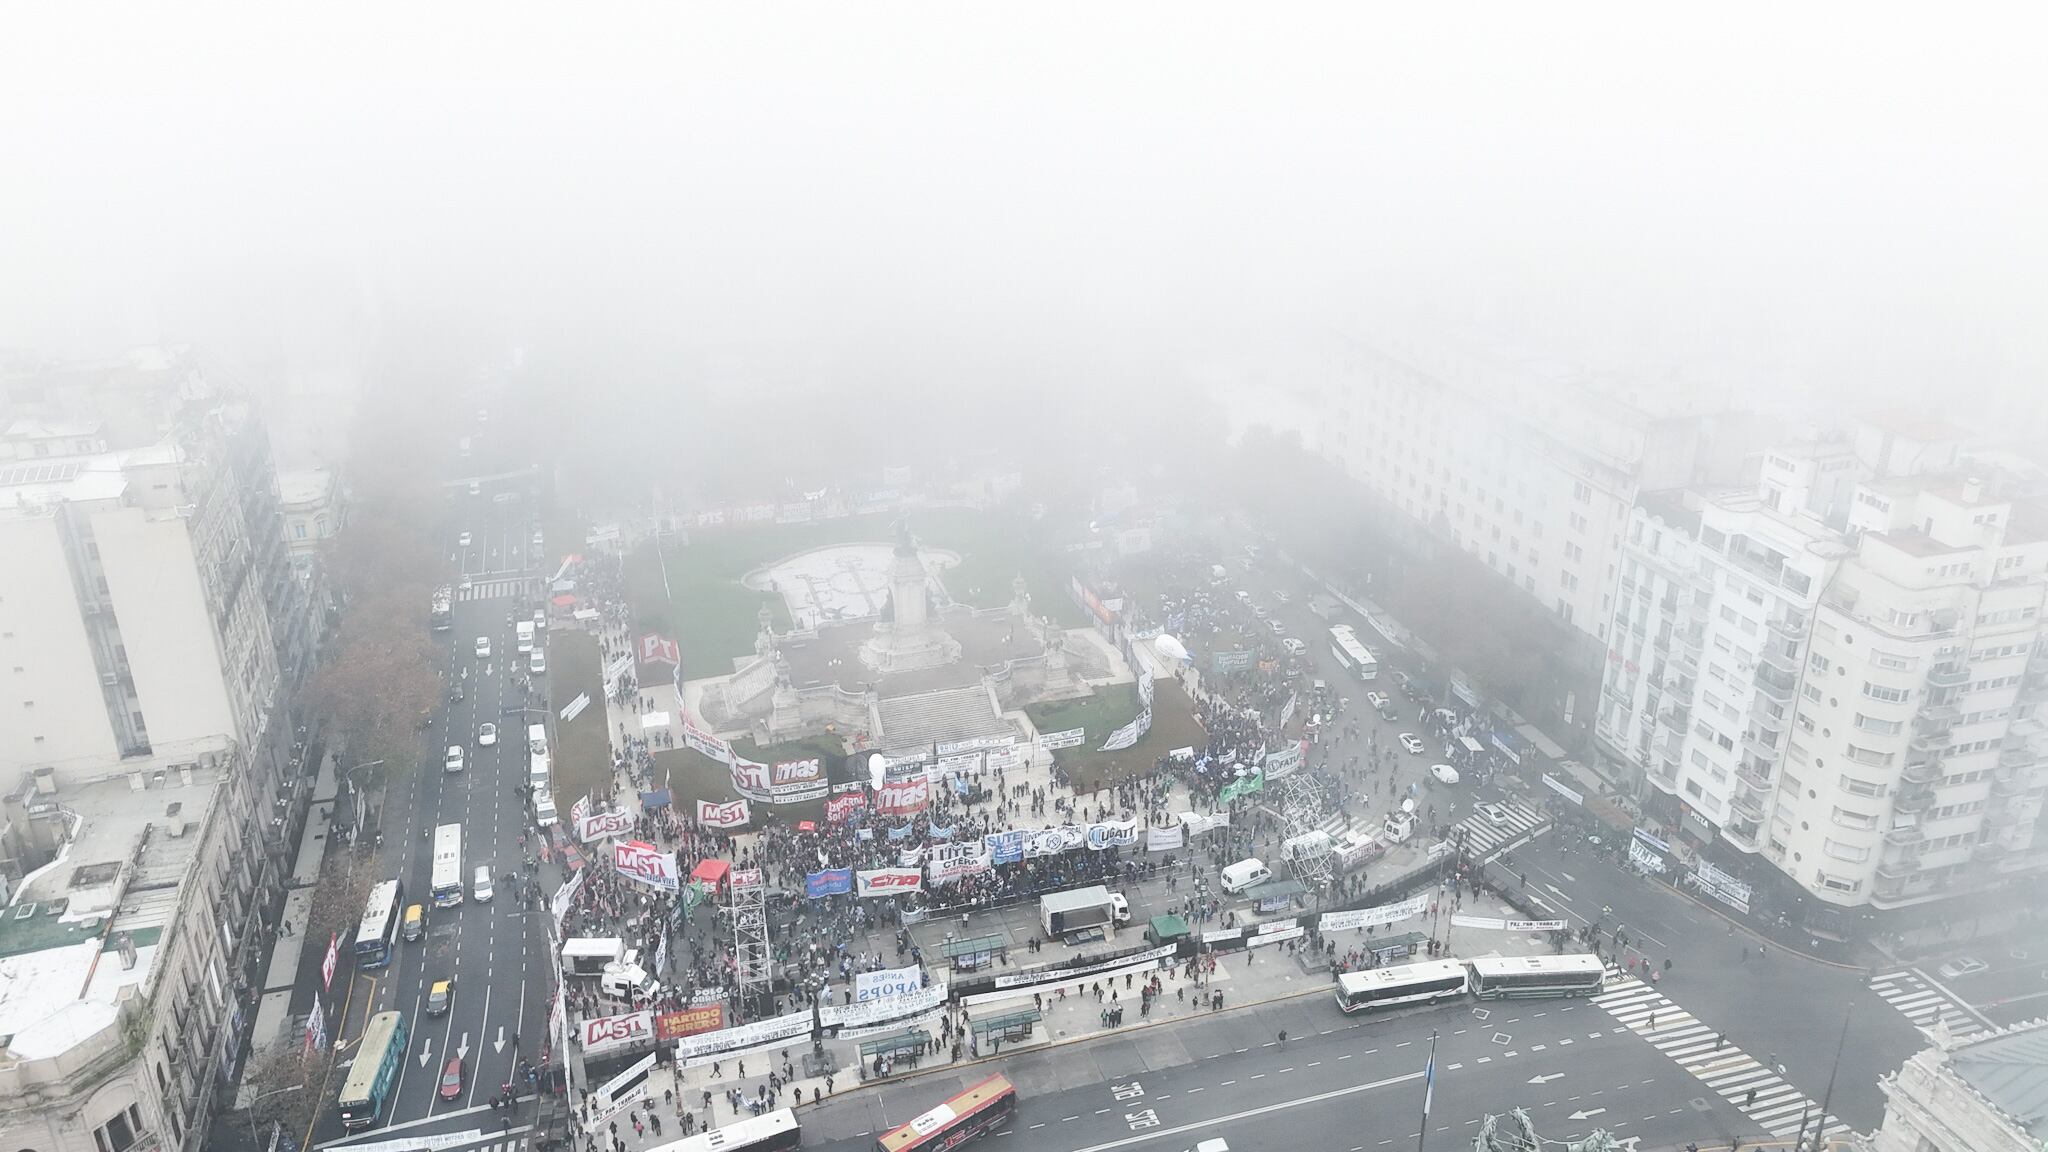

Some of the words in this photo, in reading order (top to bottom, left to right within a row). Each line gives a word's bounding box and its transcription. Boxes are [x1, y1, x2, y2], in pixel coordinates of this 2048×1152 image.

[877, 784, 928, 809] mas
[703, 801, 746, 825] MST
[587, 814, 631, 838] MST
[615, 846, 667, 878] MST
[870, 873, 920, 888] CTA
[691, 991, 729, 1004] OBRERO
[695, 986, 724, 997] POLO
[591, 1016, 642, 1044] MST
[663, 1008, 721, 1030] PARTIDO
[664, 1017, 721, 1036] OBRERO
